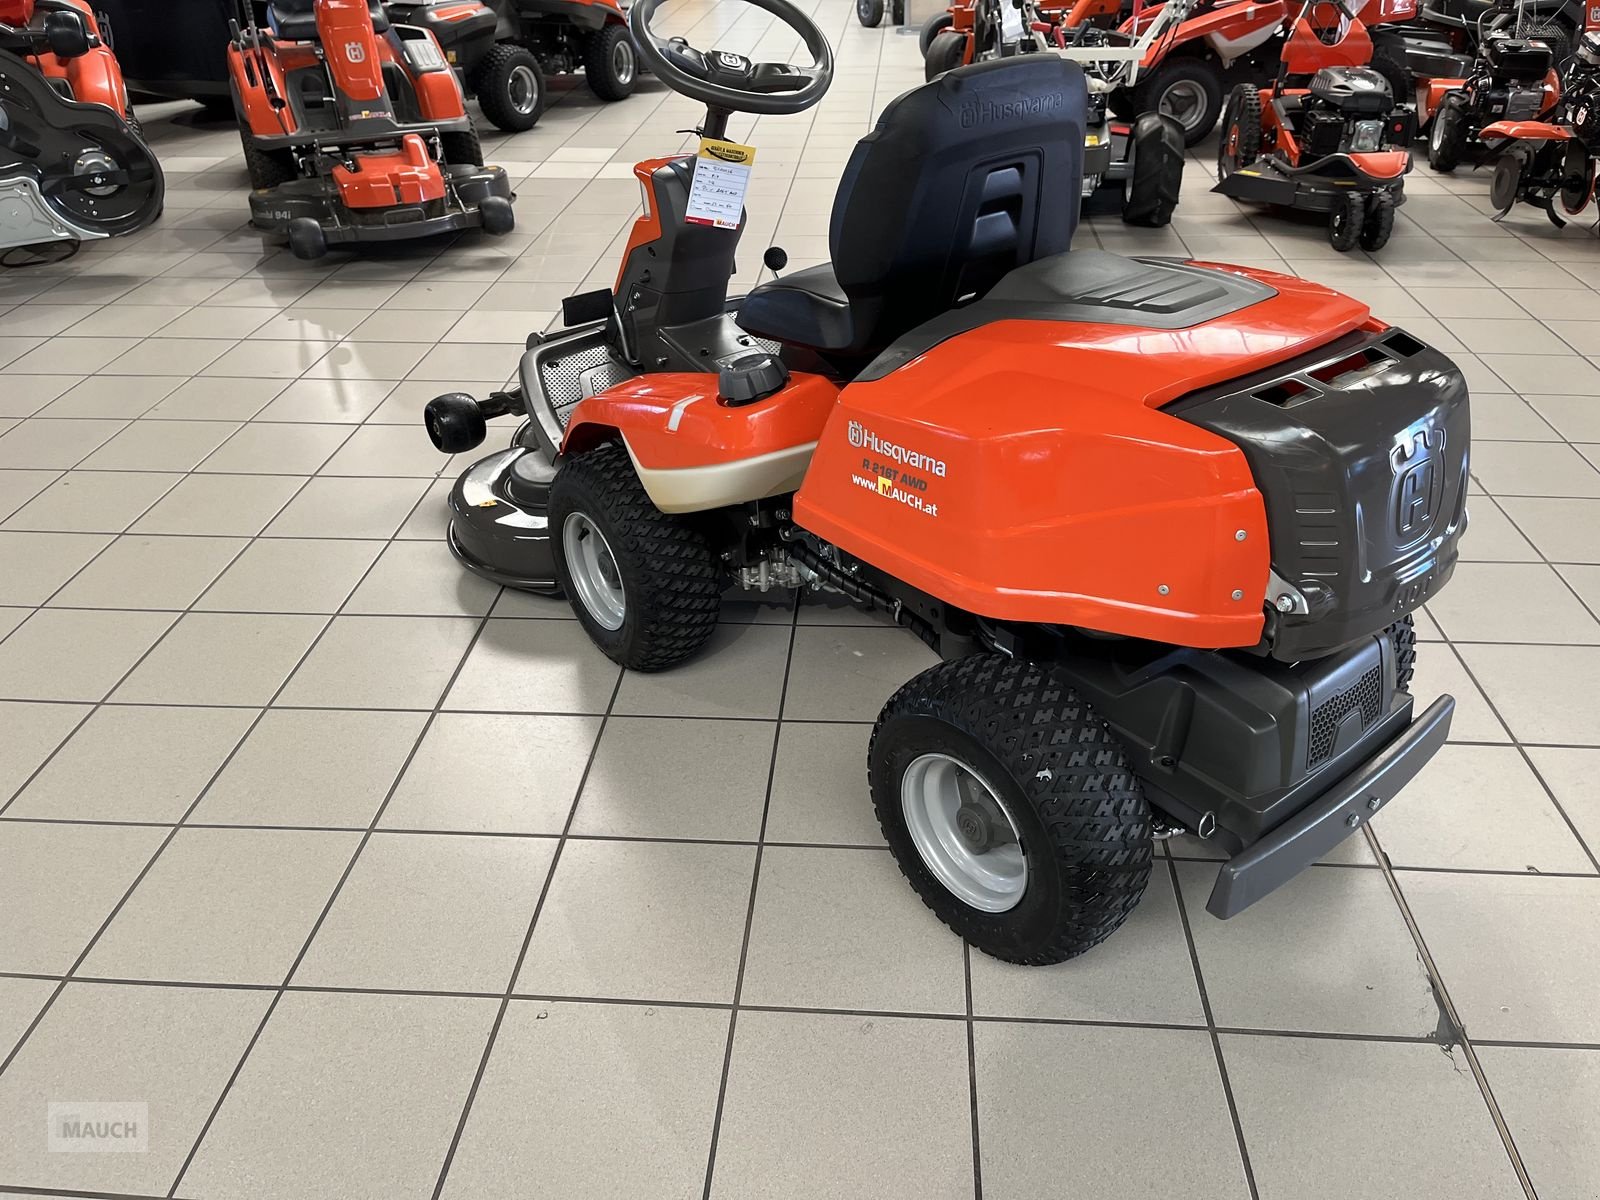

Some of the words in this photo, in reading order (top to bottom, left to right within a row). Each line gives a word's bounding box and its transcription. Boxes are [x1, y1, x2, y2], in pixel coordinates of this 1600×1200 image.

[981, 92, 1063, 124] Husqvarna
[863, 429, 946, 477] Husqvarna
[863, 458, 870, 470] R
[901, 473, 927, 492] AWD
[852, 474, 938, 517] www.MAUCH.at
